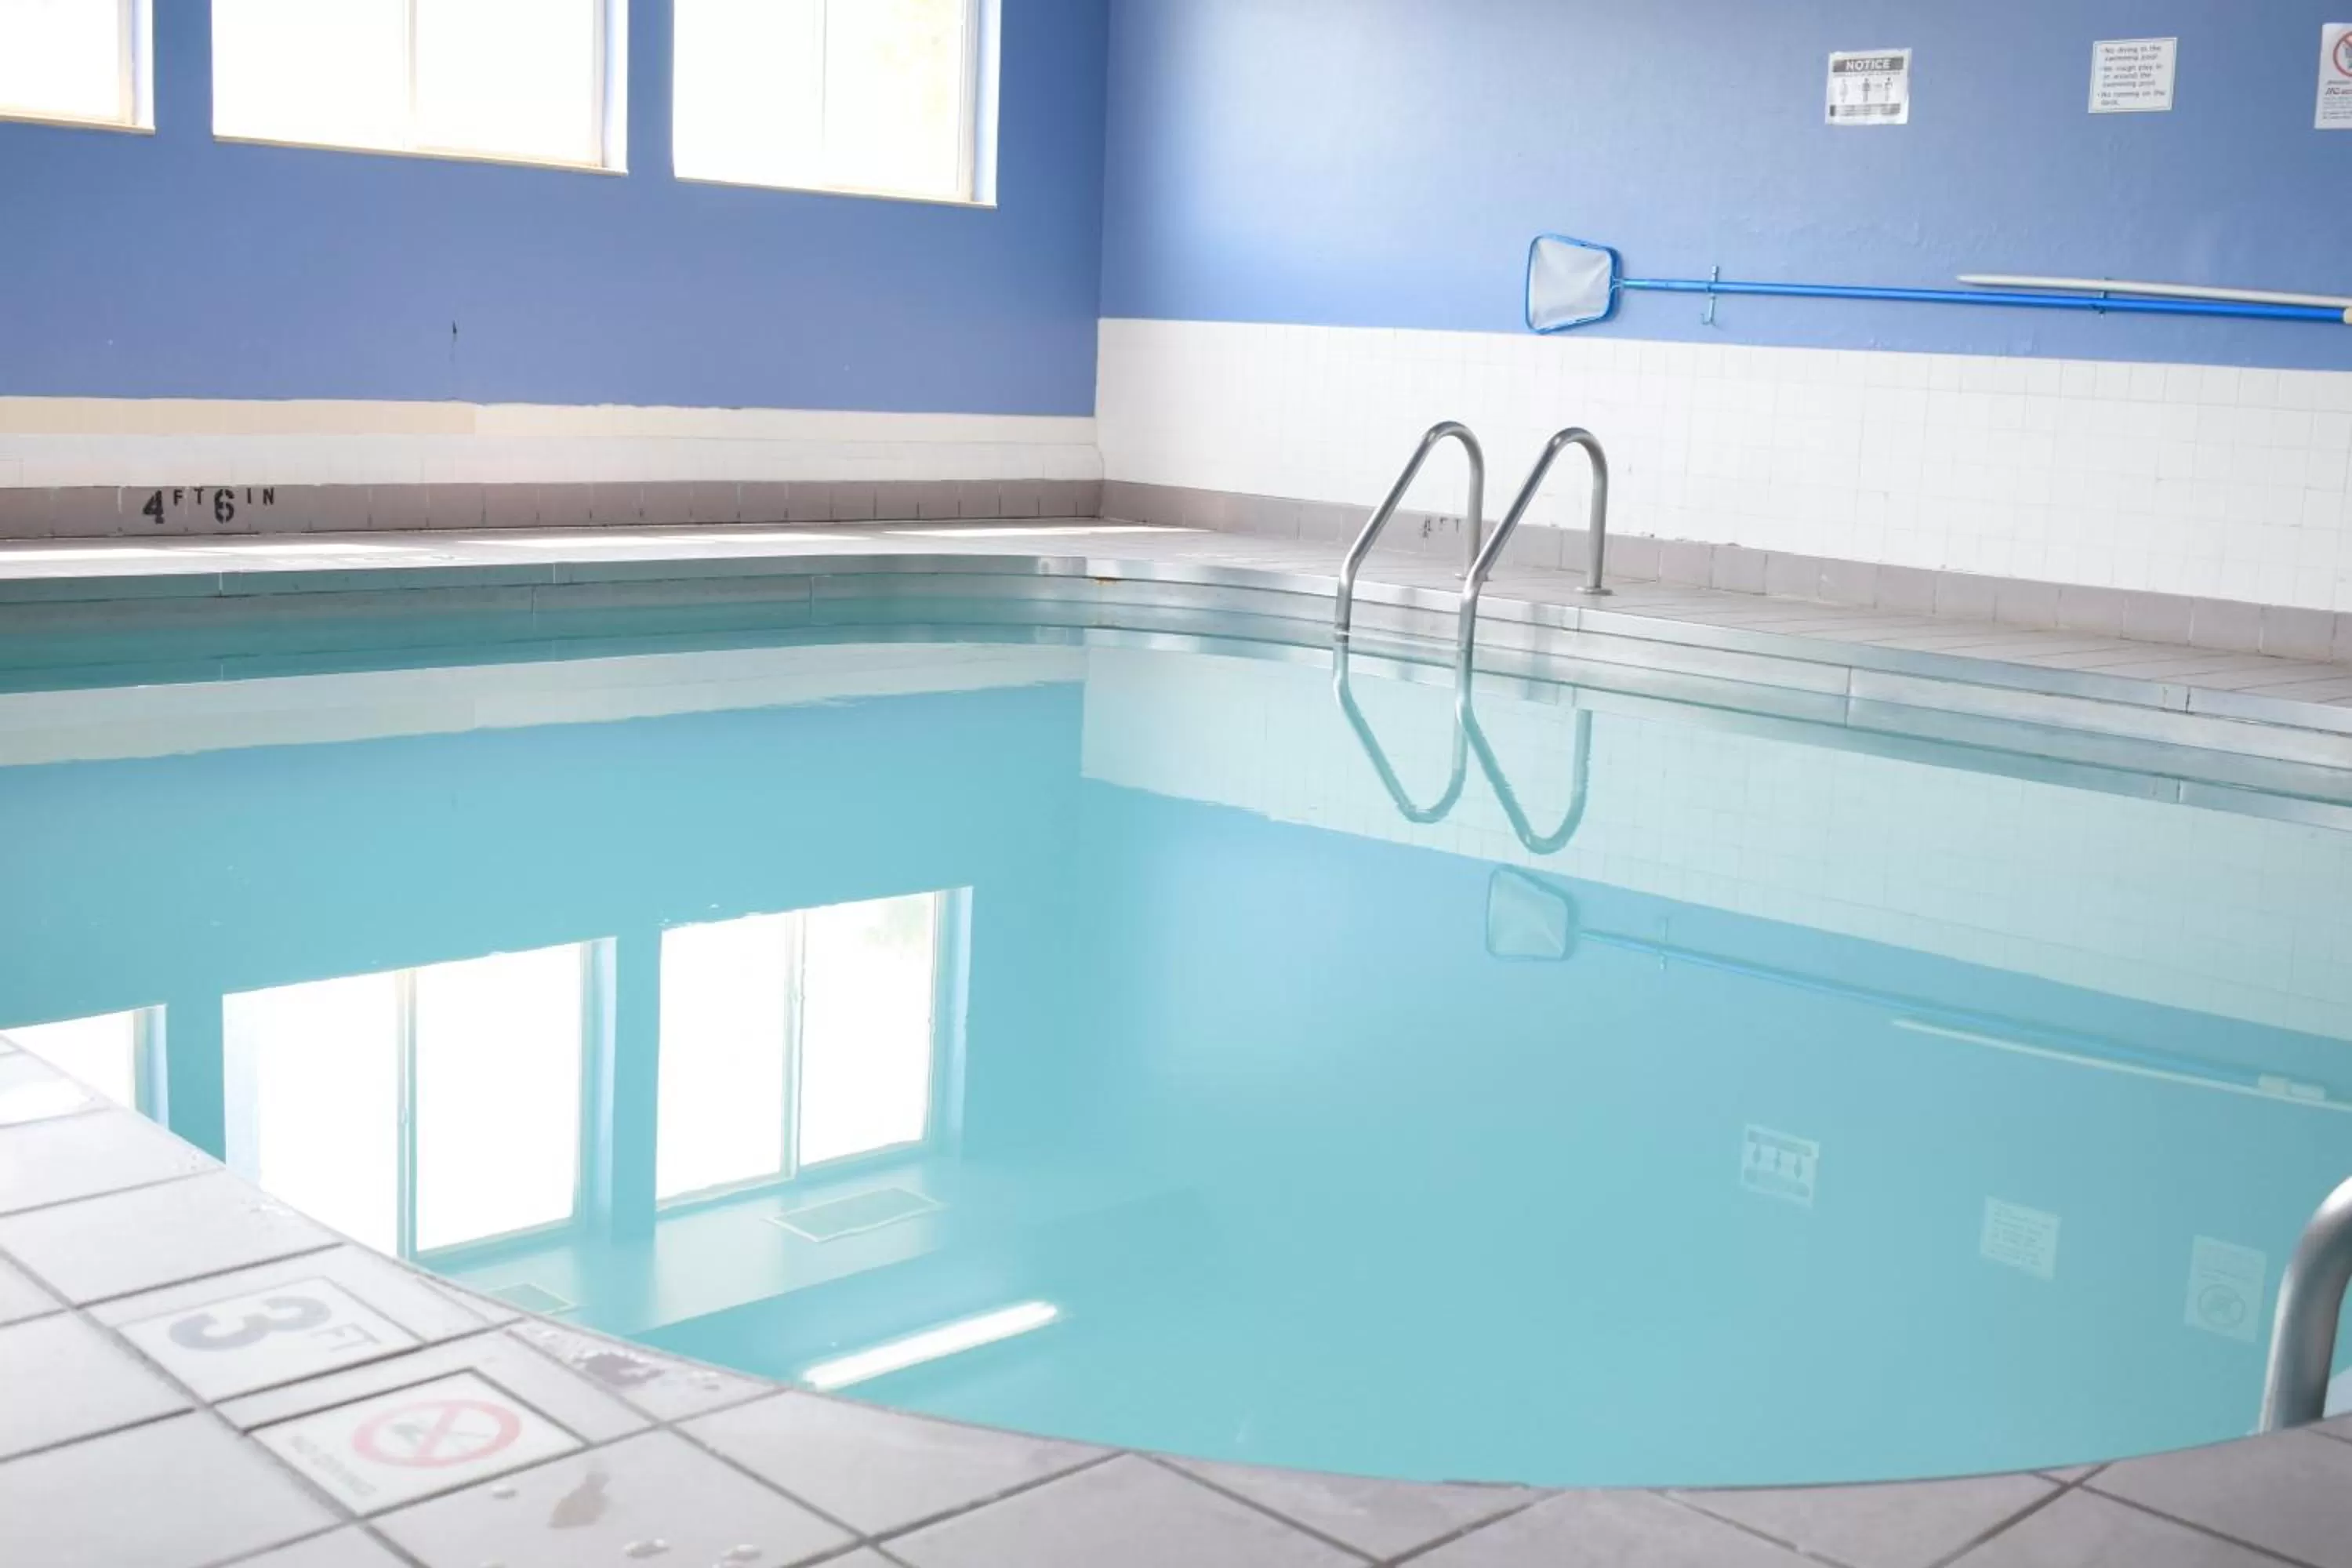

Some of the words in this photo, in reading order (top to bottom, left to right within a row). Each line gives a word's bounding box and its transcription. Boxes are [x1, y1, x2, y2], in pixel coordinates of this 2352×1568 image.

[1846, 58, 1891, 71] NOTICE
[142, 489, 165, 524] 4
[172, 488, 205, 507] FT
[213, 488, 235, 524] 6
[246, 486, 275, 506] IN
[168, 1295, 332, 1352] 3
[310, 1322, 382, 1353] FT
